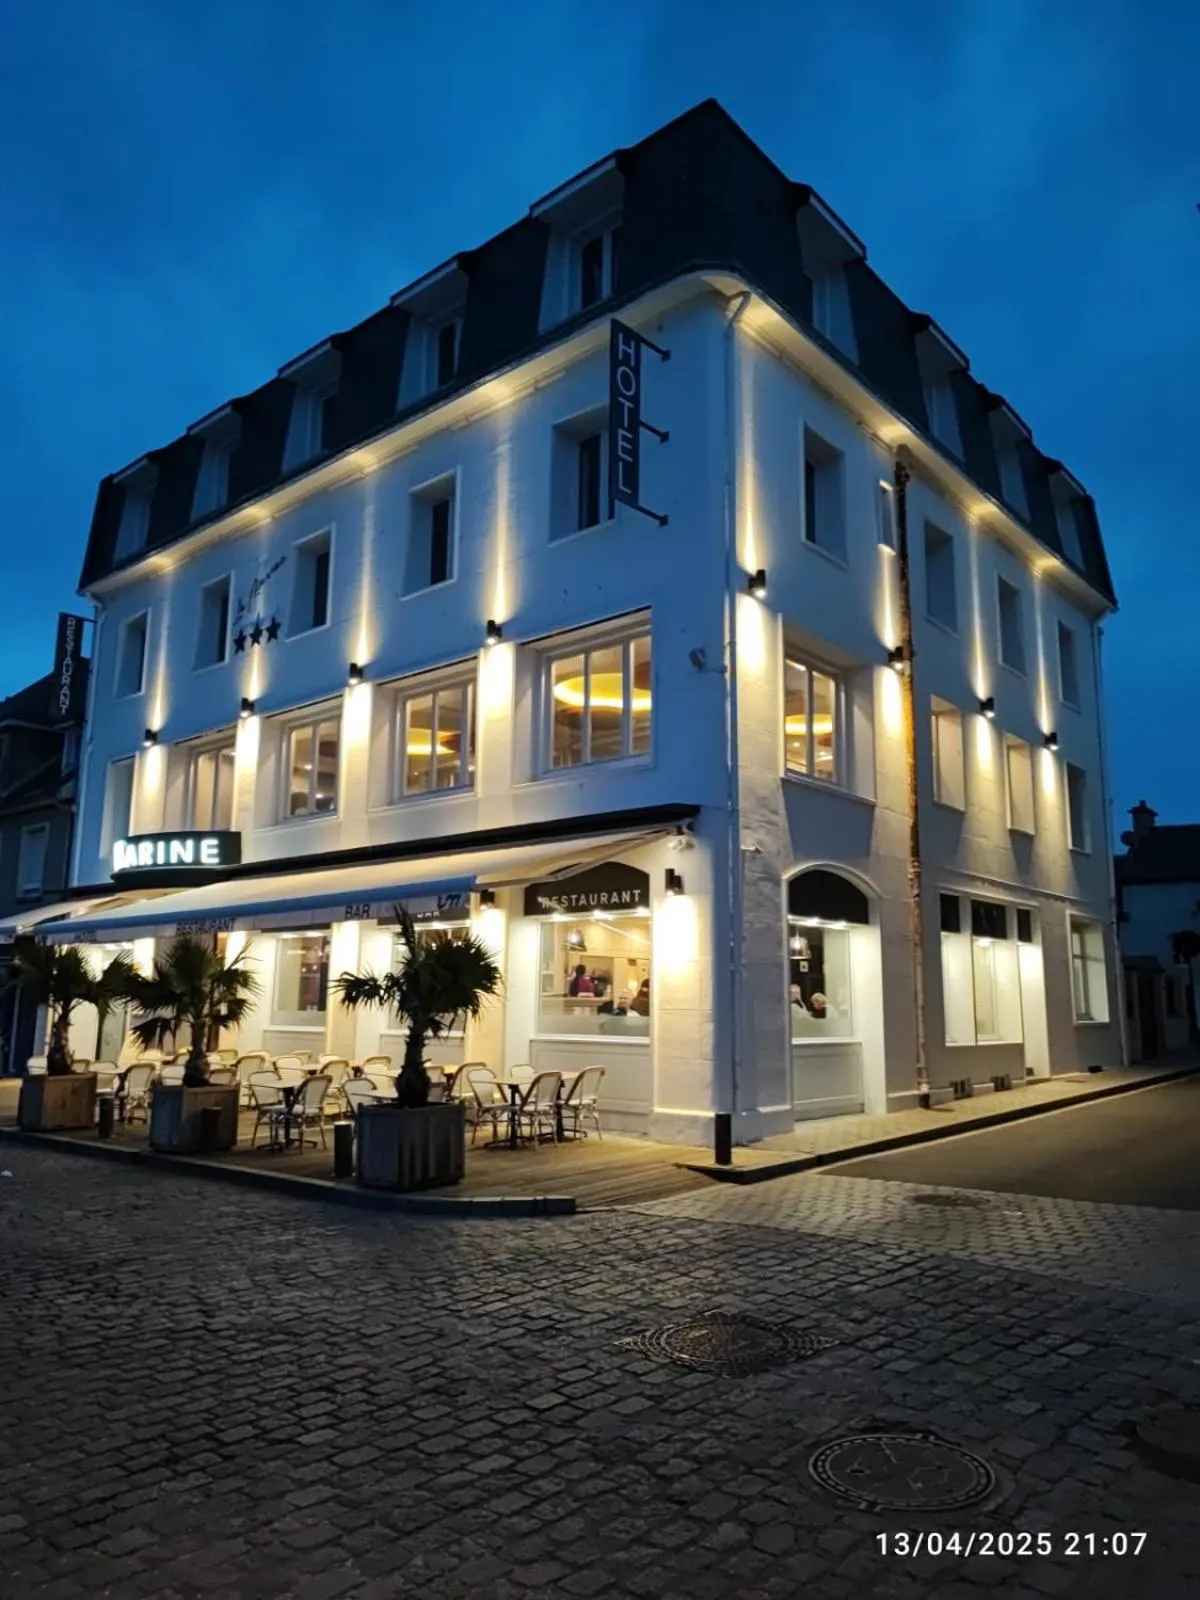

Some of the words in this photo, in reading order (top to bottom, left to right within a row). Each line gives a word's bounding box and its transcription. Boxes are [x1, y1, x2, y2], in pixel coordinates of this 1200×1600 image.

[616, 332, 636, 495] HOTEL
[60, 616, 76, 715] RESTAURANT
[345, 903, 371, 919] BAR
[542, 889, 641, 908] RESTAURANT
